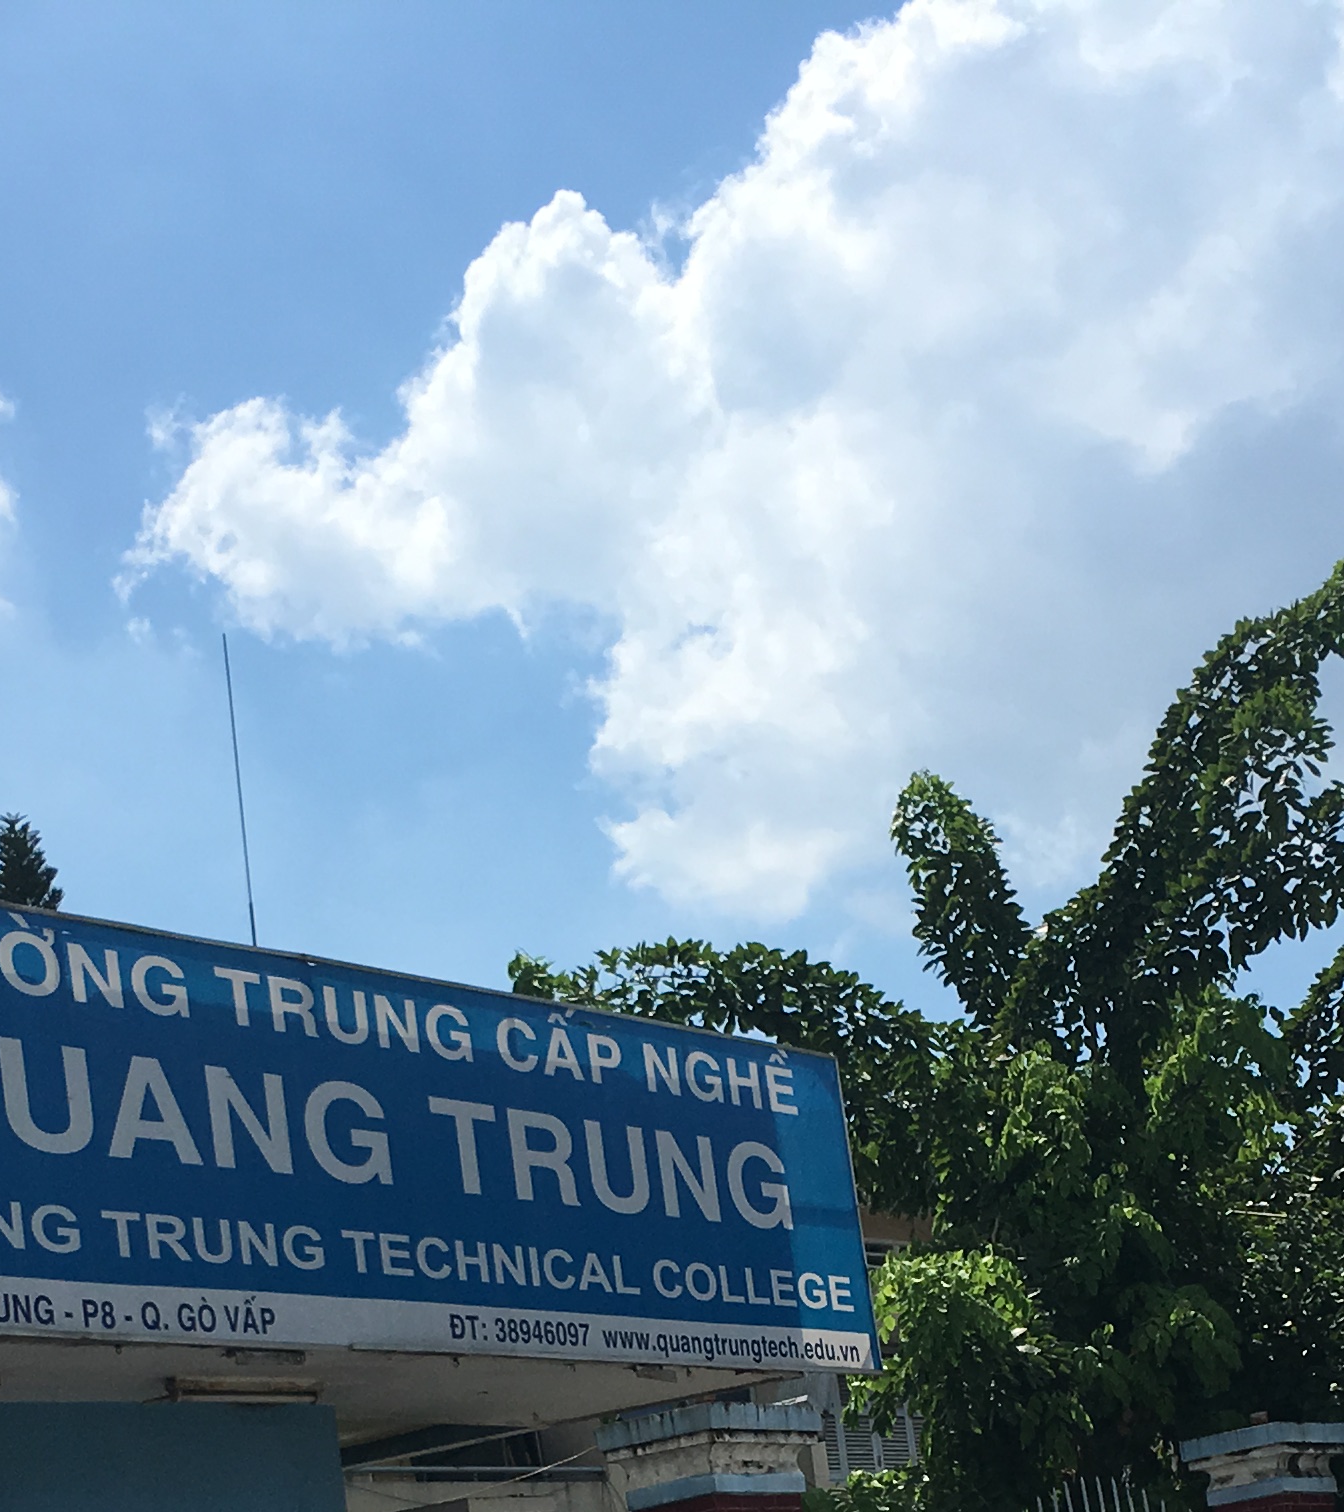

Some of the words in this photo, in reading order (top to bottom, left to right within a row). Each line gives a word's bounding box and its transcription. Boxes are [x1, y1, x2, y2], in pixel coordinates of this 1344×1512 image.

[214, 967, 474, 1063] TRUNG
[497, 1010, 621, 1084] CẤP
[644, 1042, 799, 1116] NGHỀ
[429, 1095, 793, 1231] TRUNG
[102, 1211, 325, 1270] TRUNG
[341, 1230, 641, 1295] TECHNICAL
[654, 1260, 855, 1312] COLLEGE
[83, 1298, 116, 1331] P8
[142, 1301, 169, 1332] Q.
[178, 1297, 216, 1333] GÒ
[225, 1296, 276, 1334] VẤP
[450, 1314, 487, 1341] ĐT:
[495, 1318, 589, 1348] 38946097
[602, 1328, 860, 1364] www.quangtrungtech.edu.vn
